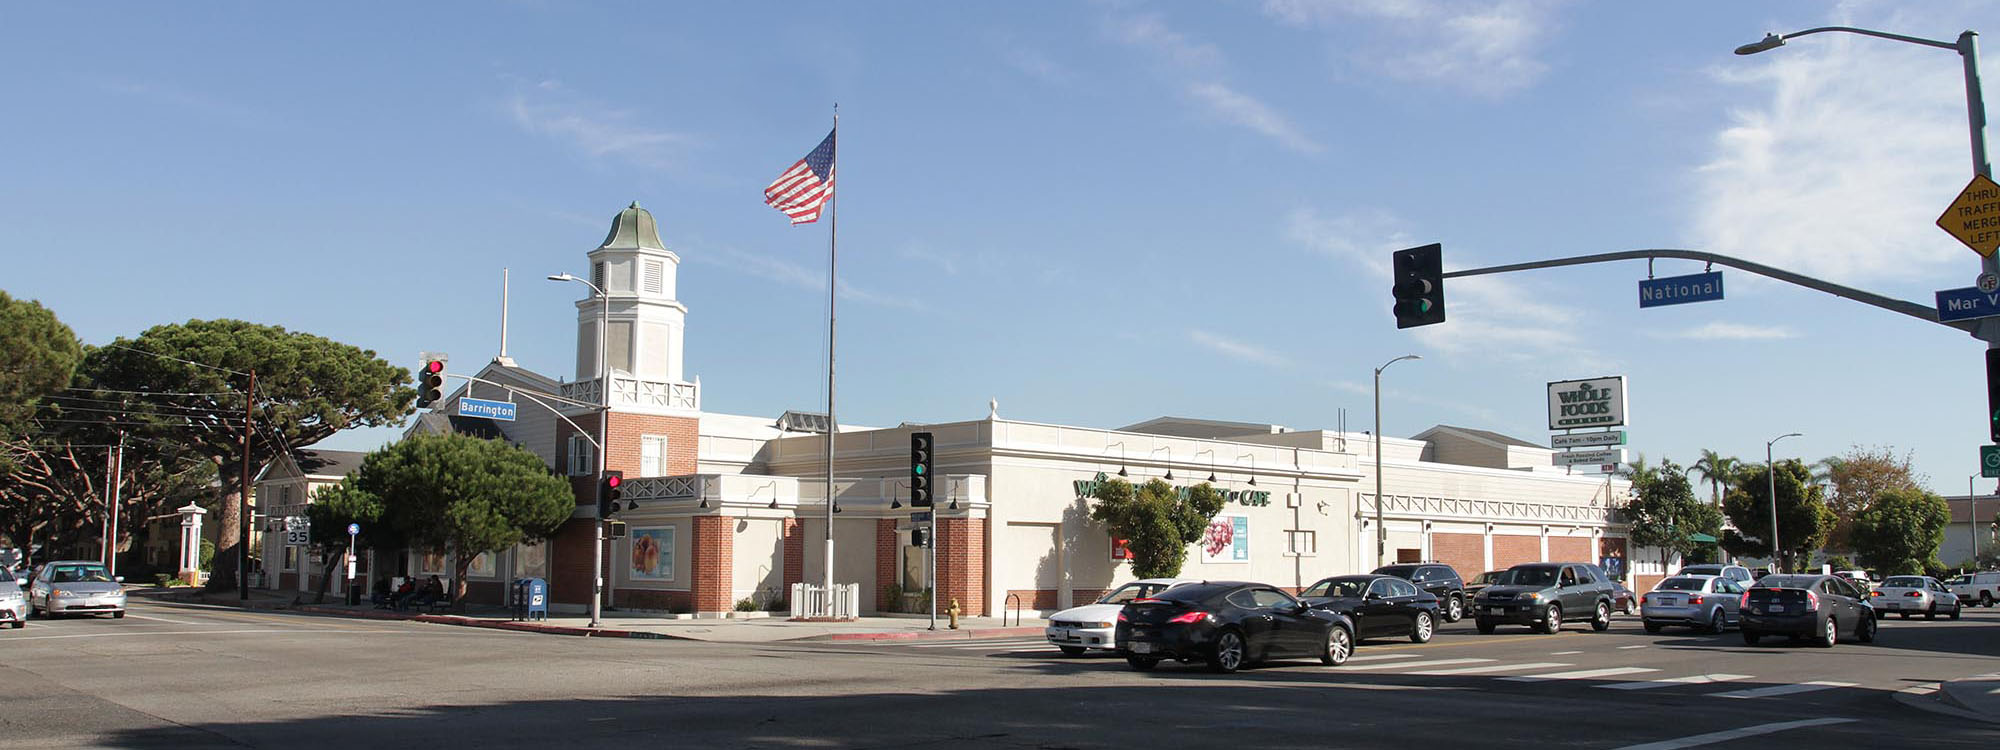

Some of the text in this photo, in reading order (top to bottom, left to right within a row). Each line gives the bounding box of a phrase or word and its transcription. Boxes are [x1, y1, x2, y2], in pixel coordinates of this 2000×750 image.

[1966, 188, 1998, 201] THRU
[1970, 231, 2000, 244] LEFT
[1642, 279, 1720, 300] National
[1948, 298, 1980, 311] Mar
[1557, 387, 1612, 404] WHOLE
[461, 401, 514, 417] Barrington
[1560, 401, 1610, 417] FOODS
[289, 532, 308, 542] 35
